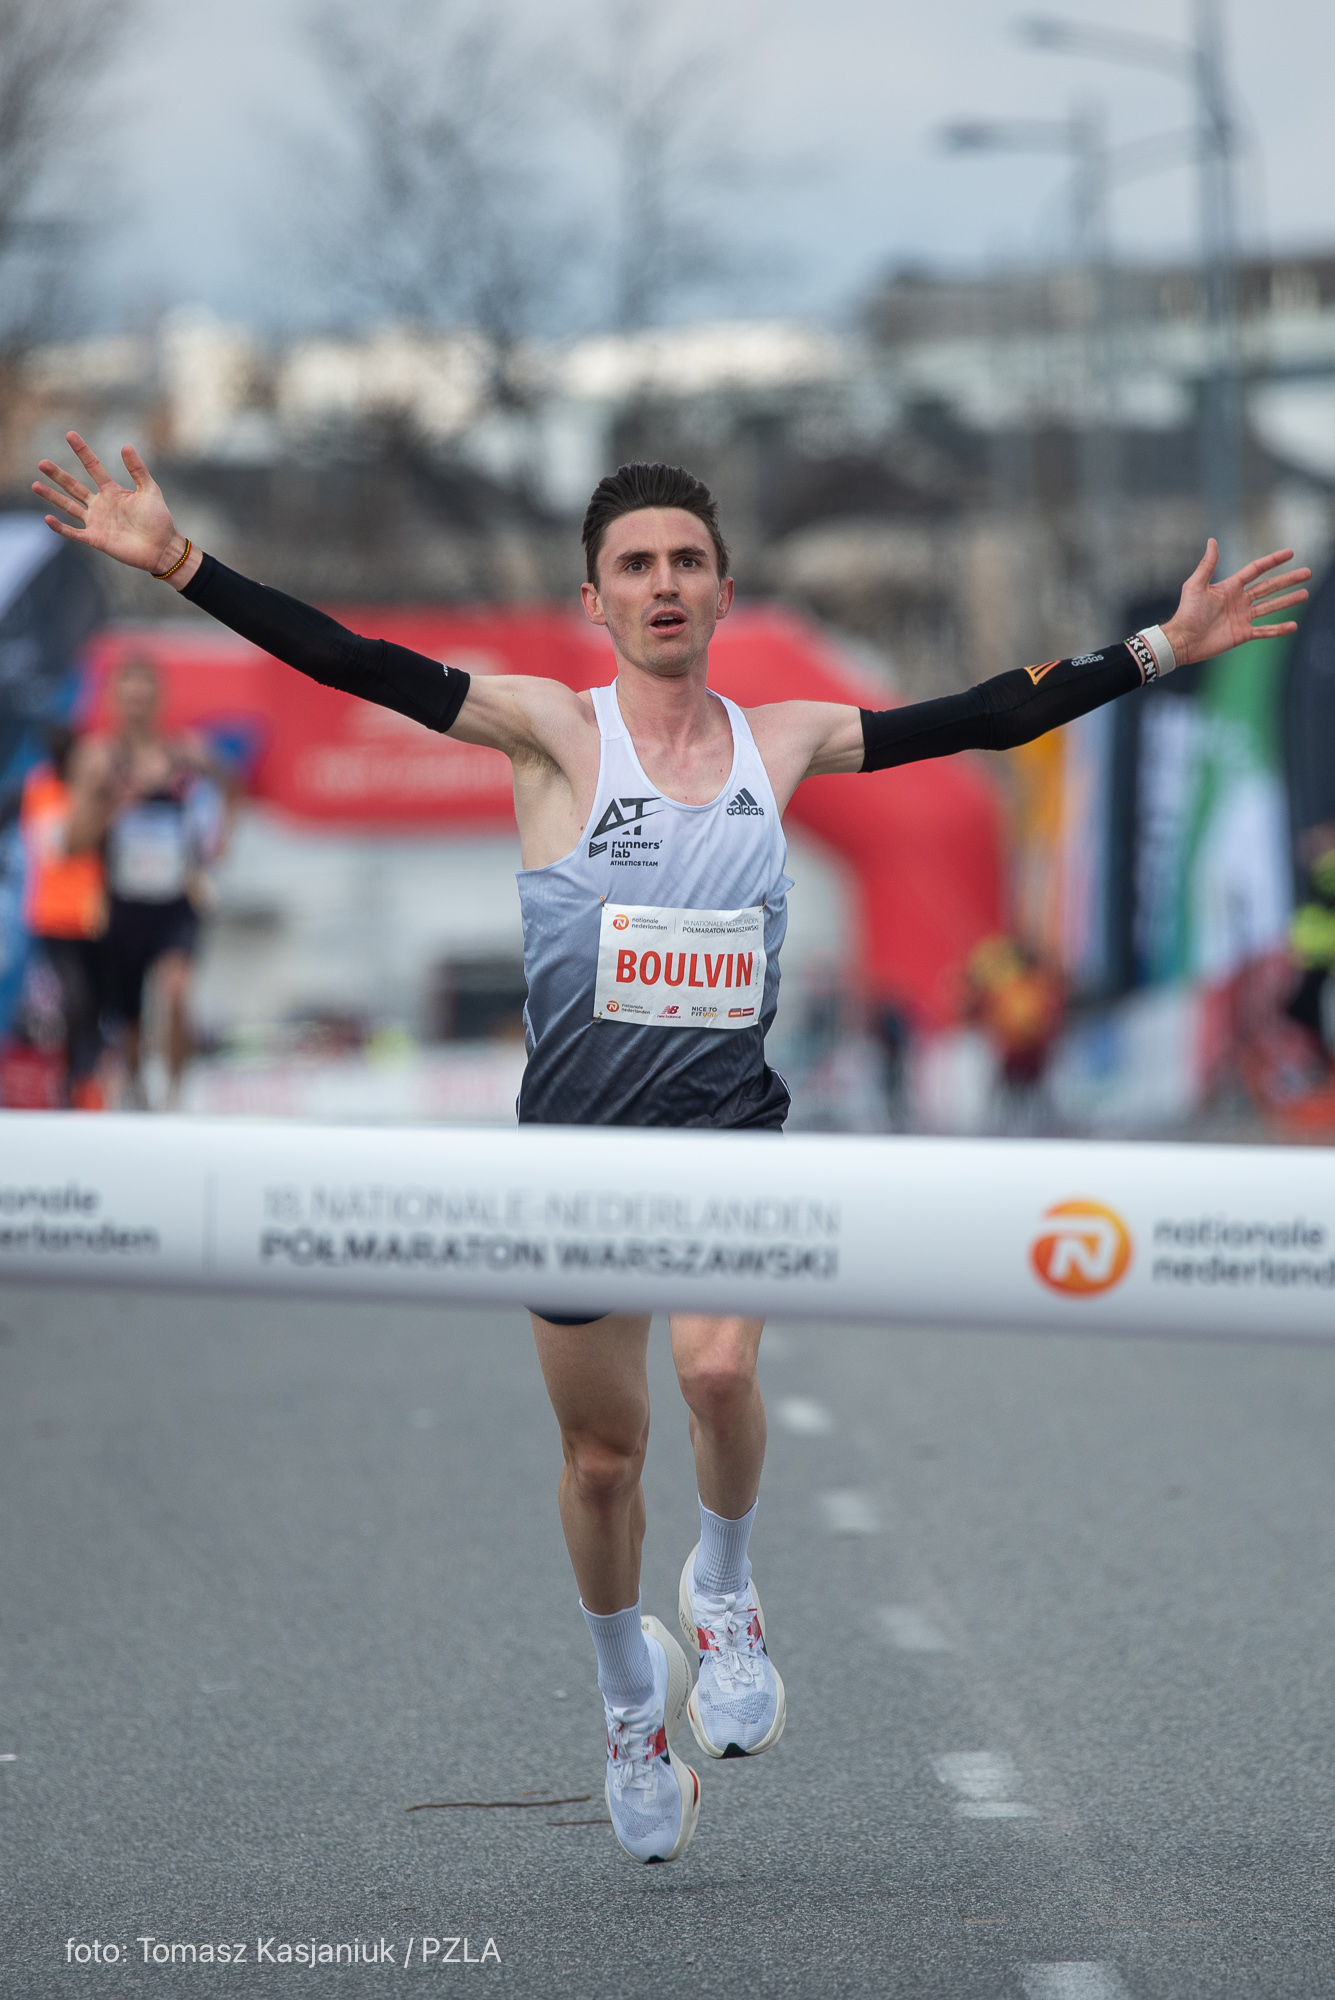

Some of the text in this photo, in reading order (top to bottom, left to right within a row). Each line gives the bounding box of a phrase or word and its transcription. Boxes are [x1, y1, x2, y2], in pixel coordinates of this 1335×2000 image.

[1071, 655, 1104, 667] adidas
[726, 803, 764, 816] adidas
[612, 839, 663, 850] runners'
[611, 849, 631, 859] lab
[726, 924, 759, 934] WARSZAWSKI
[616, 949, 753, 988] BOULVIN
